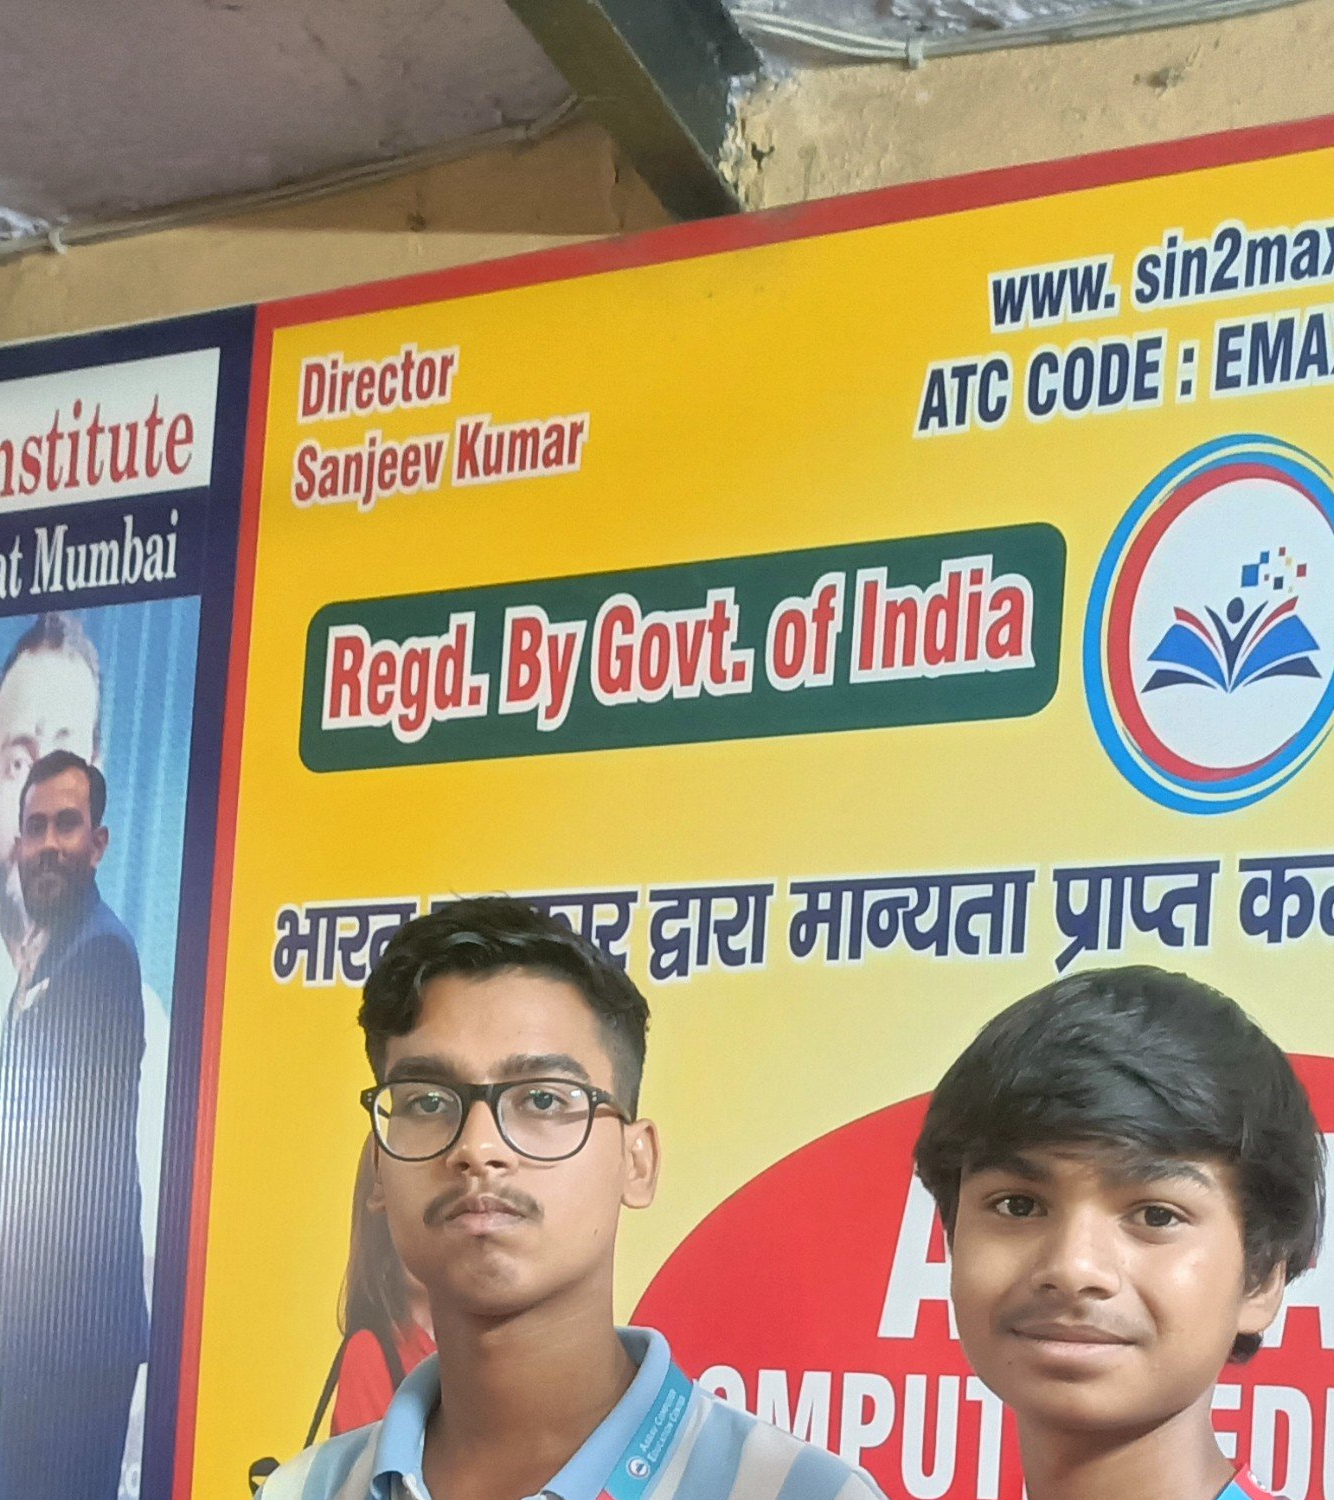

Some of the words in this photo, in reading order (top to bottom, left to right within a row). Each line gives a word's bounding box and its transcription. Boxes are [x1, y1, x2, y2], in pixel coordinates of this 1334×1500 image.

[992, 260, 1116, 326] www.
[301, 349, 455, 417] Director
[918, 358, 1008, 432] ATC
[1026, 336, 1161, 412] CODE
[295, 437, 445, 505] Sanjeev
[456, 418, 584, 480] Kumar
[29, 509, 178, 594] Mumbai
[329, 622, 482, 733] Regd.
[510, 615, 578, 720] By
[597, 599, 746, 694] Govt.
[773, 584, 837, 678] of
[859, 566, 1025, 670] India
[648, 884, 773, 979] द्वारा
[788, 870, 1035, 960] मान्यता
[1054, 860, 1220, 971] प्राप्त
